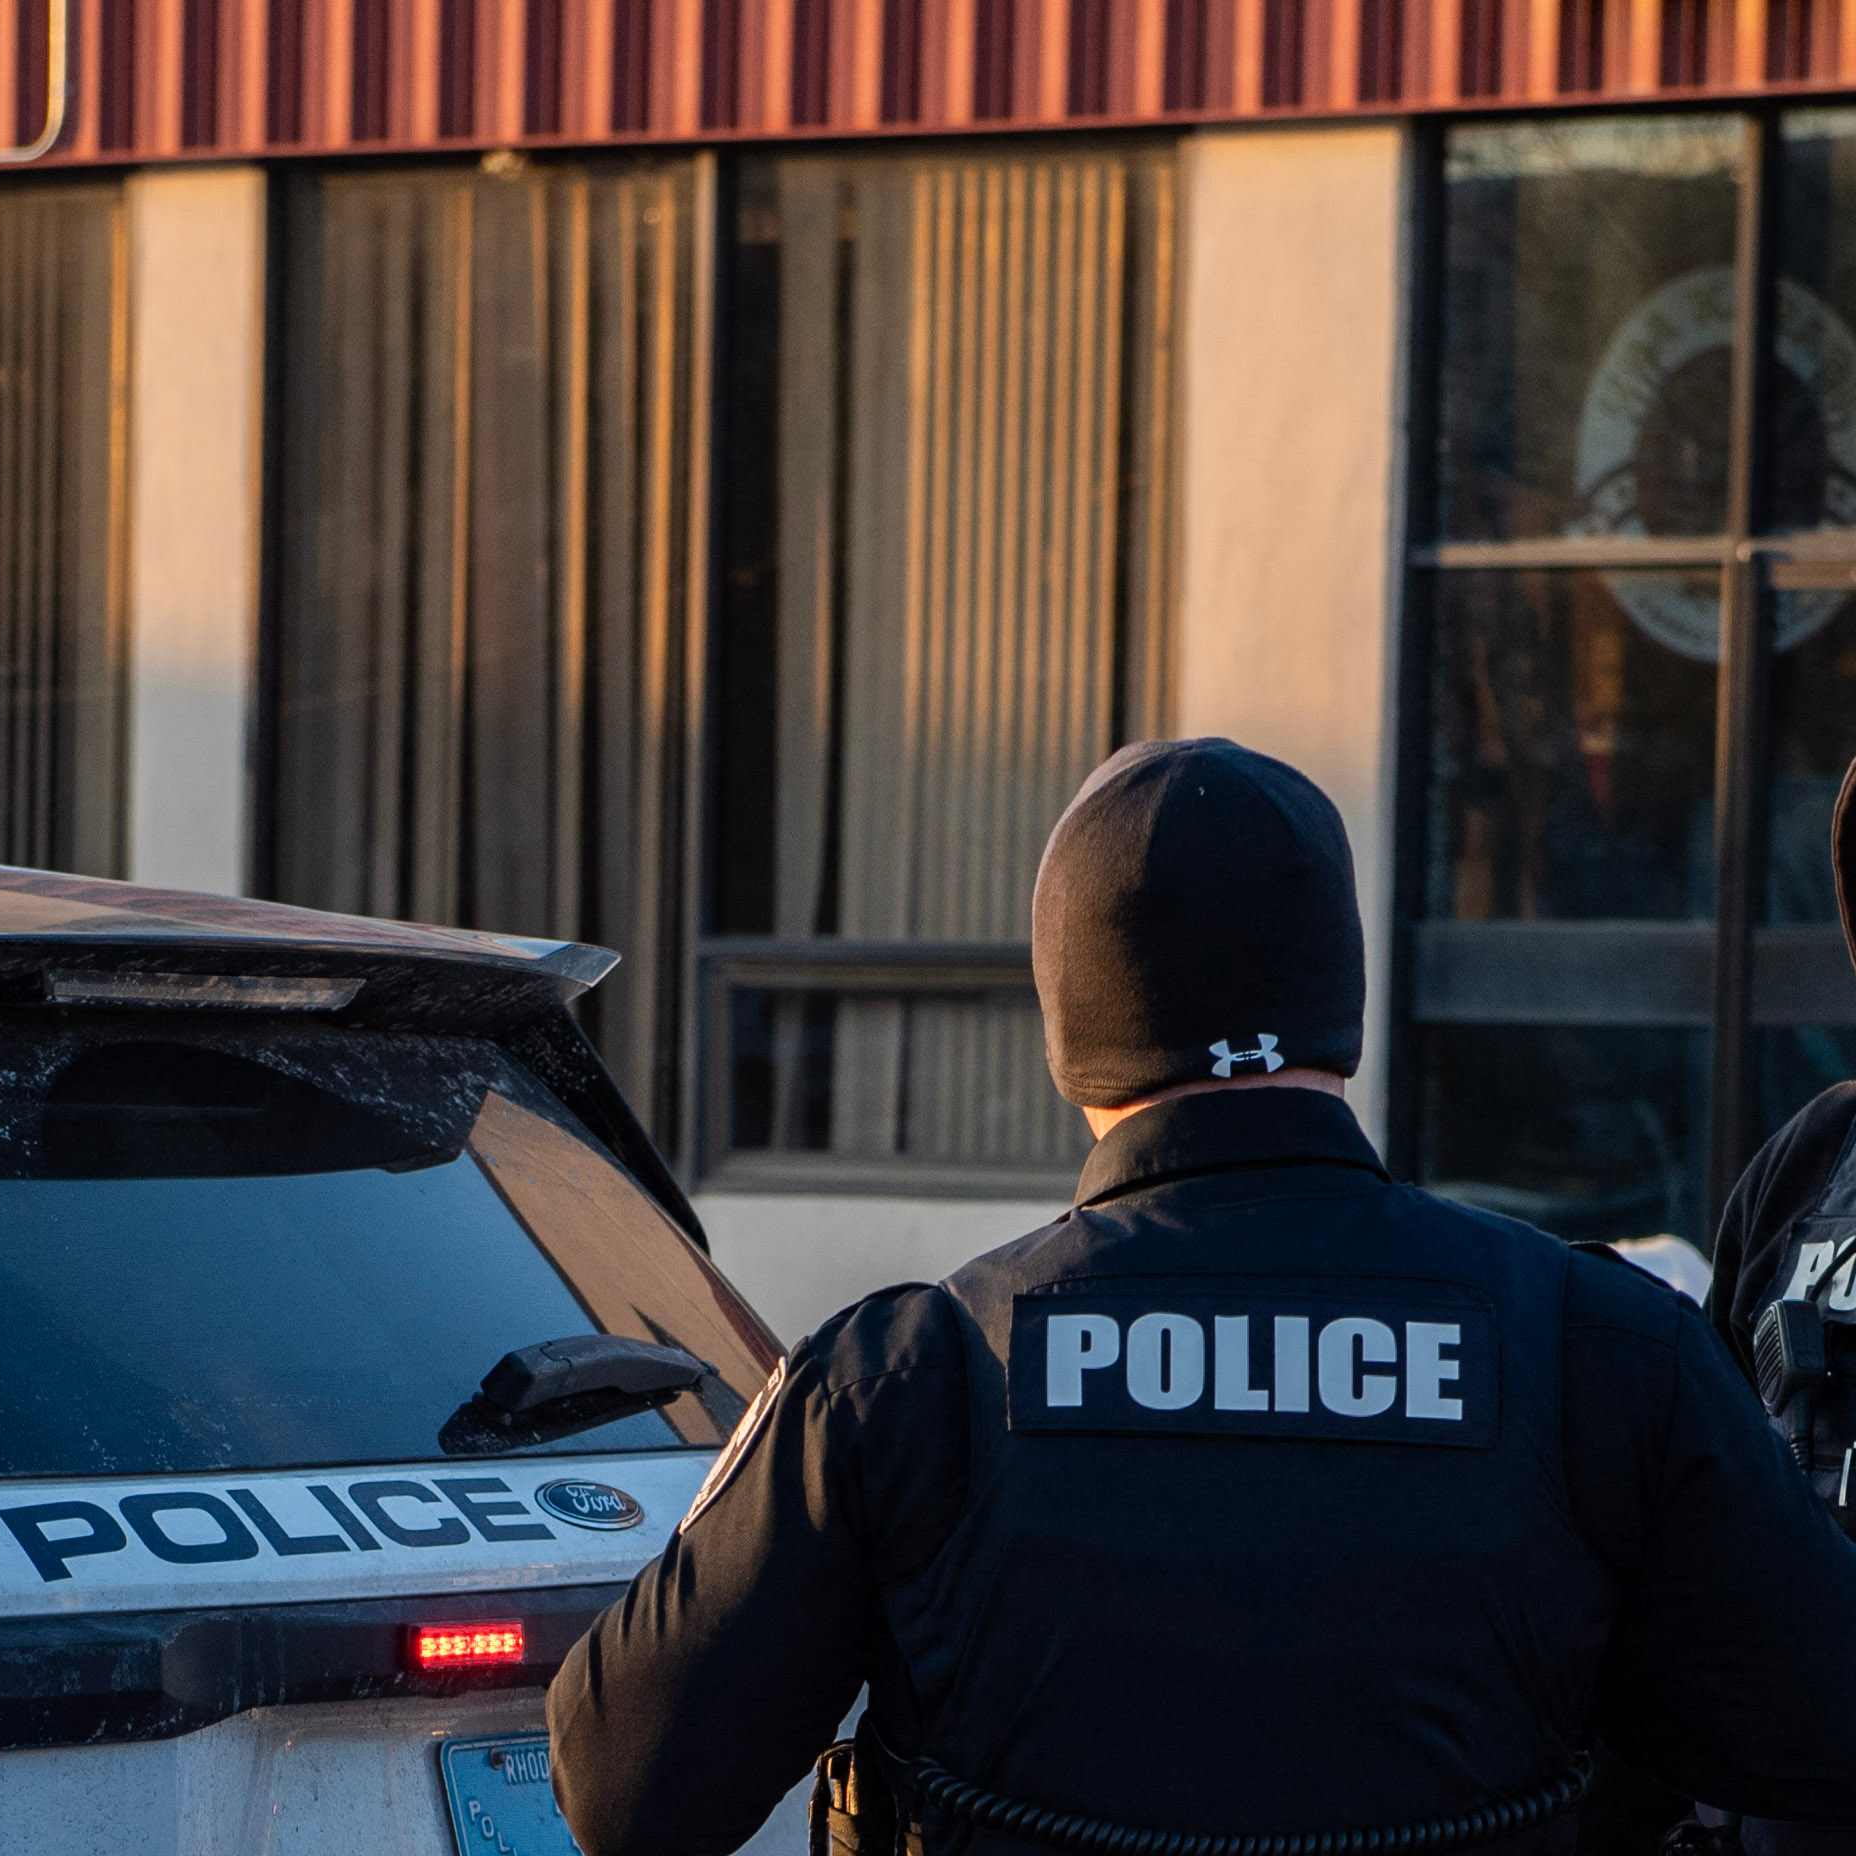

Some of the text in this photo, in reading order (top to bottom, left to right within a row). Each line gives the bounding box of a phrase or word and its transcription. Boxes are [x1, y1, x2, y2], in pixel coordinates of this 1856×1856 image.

[1045, 1311, 1463, 1421] POLICE
[565, 1484, 628, 1514] Ford
[504, 1748, 550, 1786] RHOD
